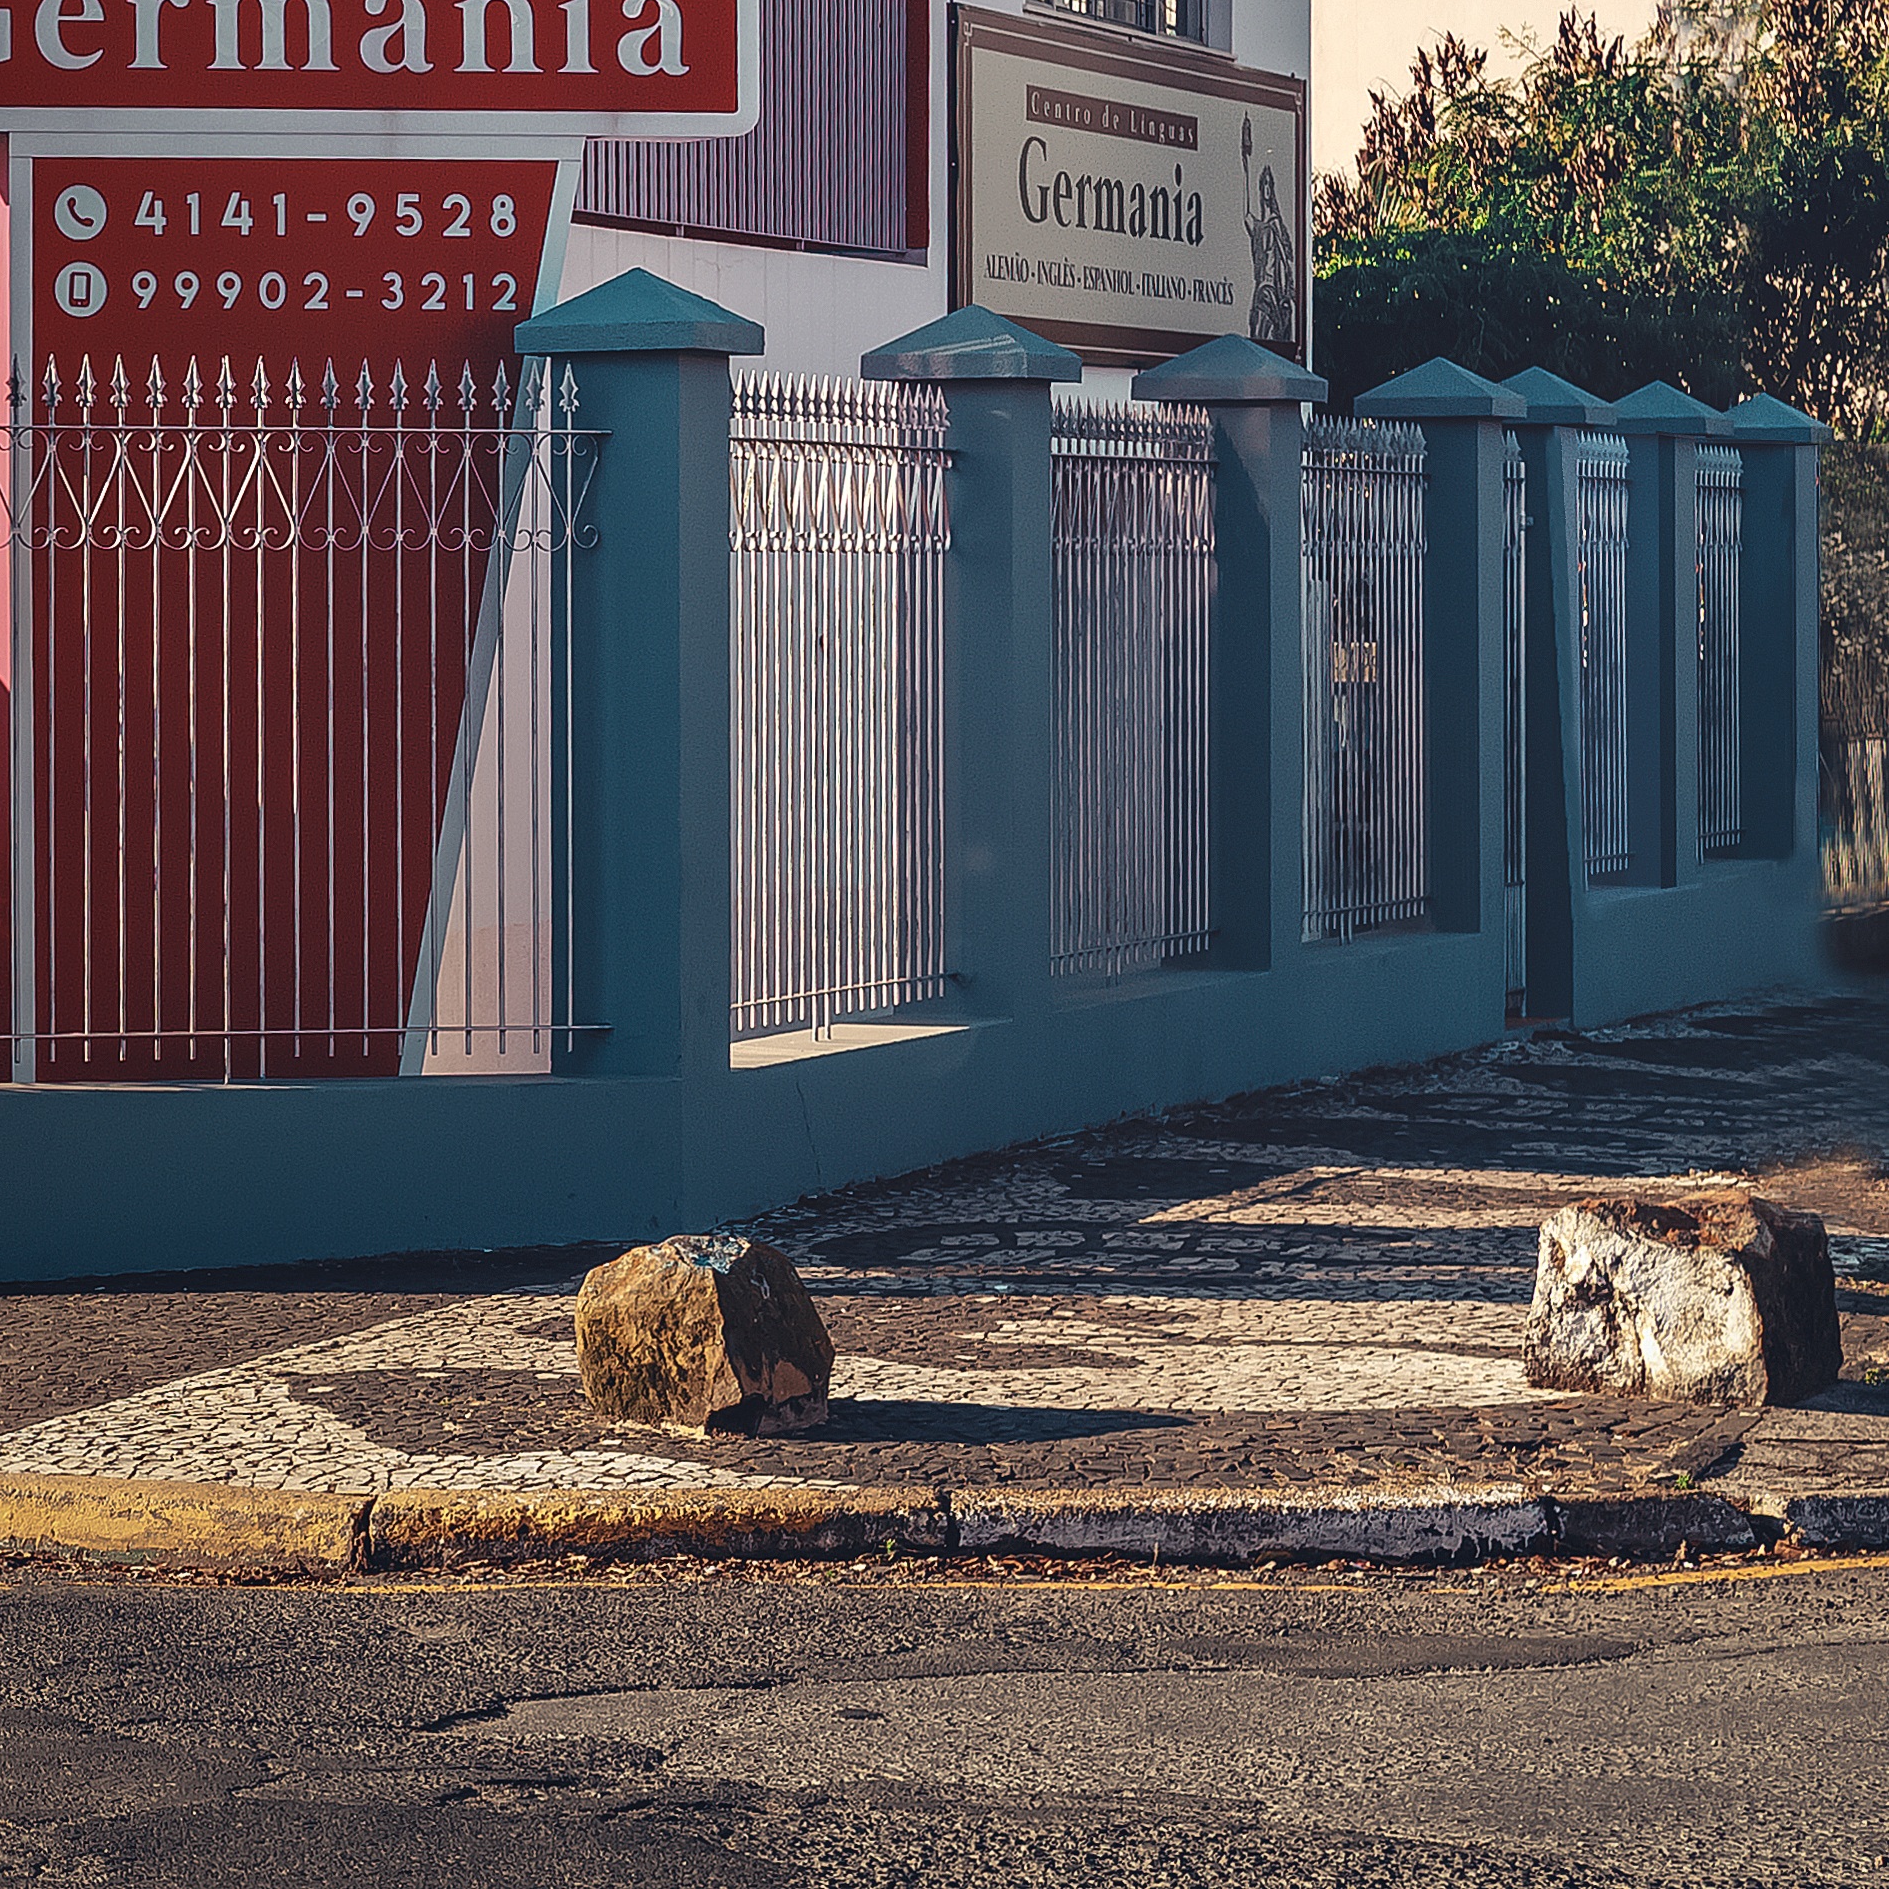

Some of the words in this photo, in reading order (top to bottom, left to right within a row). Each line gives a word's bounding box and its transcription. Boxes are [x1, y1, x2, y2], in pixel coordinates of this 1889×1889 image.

[1031, 91, 1091, 124] Centro
[1102, 104, 1119, 130] de
[134, 191, 517, 237] 4141-9528
[1019, 136, 1204, 247] Germania
[132, 271, 517, 310] 99902-3212
[985, 252, 1029, 283] ALEMÃO
[1037, 257, 1075, 289] INGLÊS
[1083, 265, 1135, 295] ESPANHOL
[1141, 272, 1186, 300] ITALIANO
[1193, 276, 1234, 305] FRANCÊS
